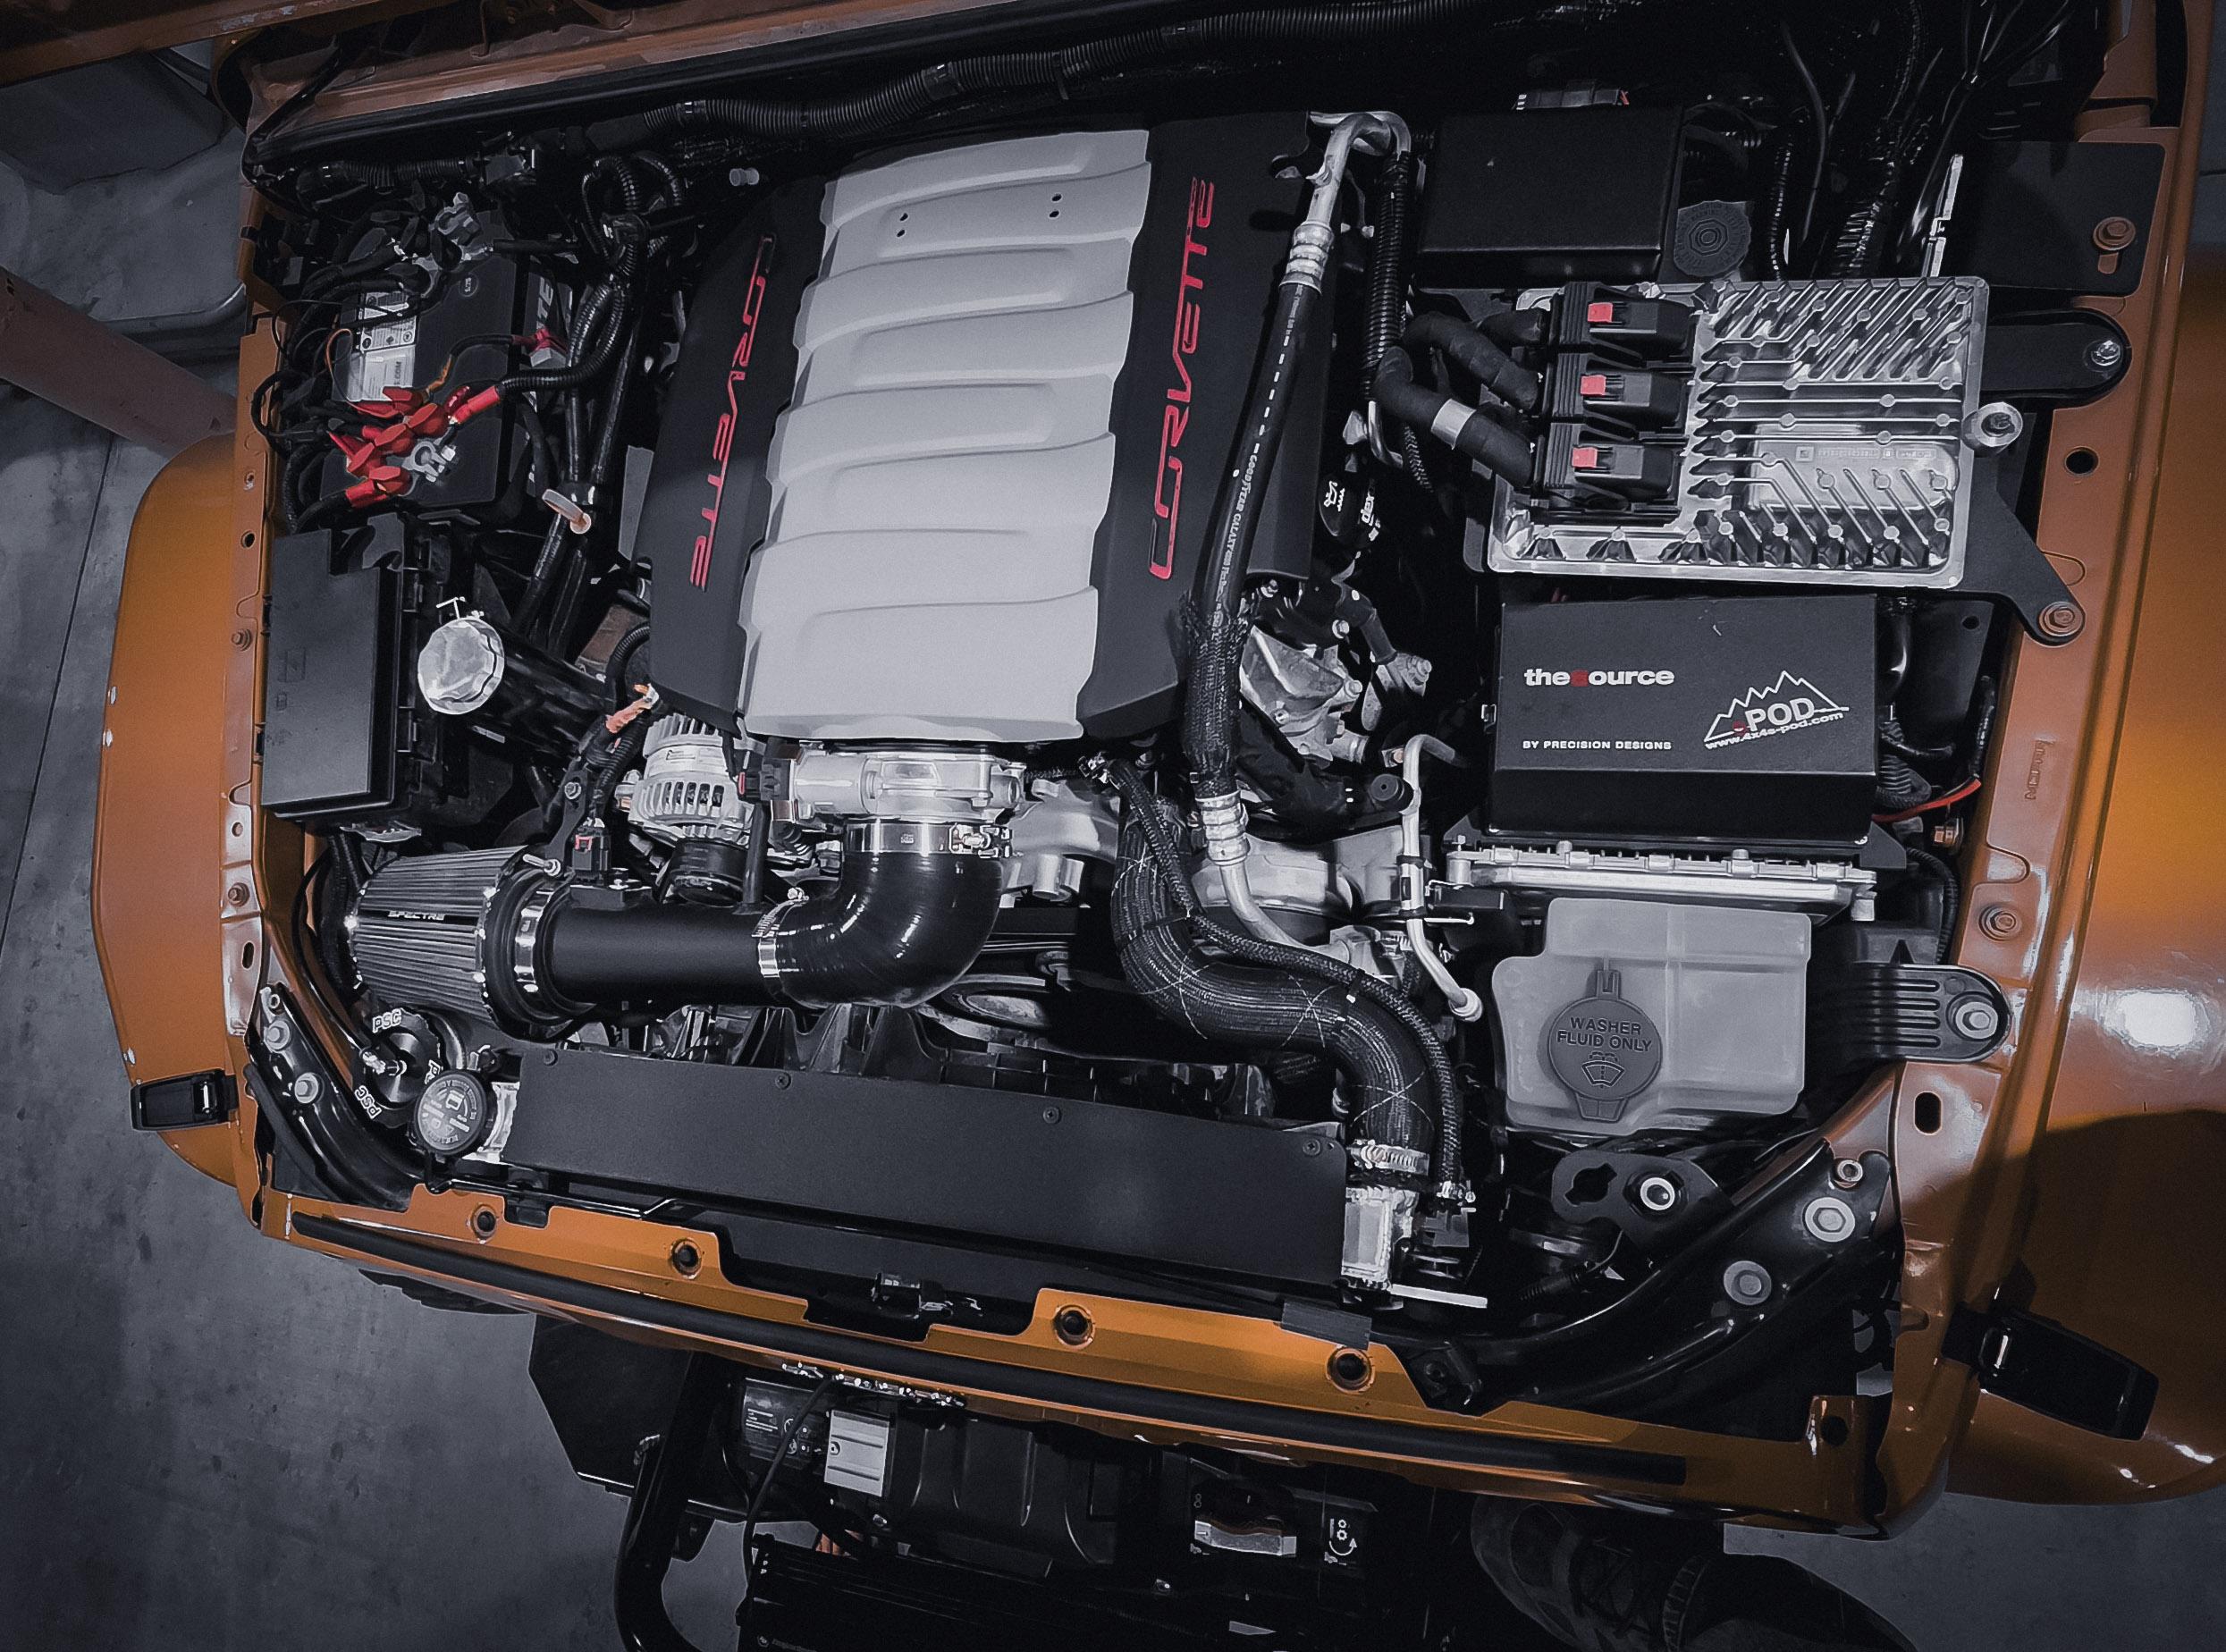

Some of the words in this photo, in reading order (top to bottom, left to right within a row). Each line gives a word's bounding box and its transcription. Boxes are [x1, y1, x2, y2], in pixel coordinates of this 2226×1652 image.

[1149, 176, 1215, 579] CORVETTE
[689, 232, 777, 593] CORVETTE
[1235, 454, 1258, 512] GOODYEAR
[1523, 668, 1675, 687] theource
[1522, 740, 1539, 749] BY
[1543, 740, 1611, 749] PRECISION
[1615, 740, 1672, 750] DESIGNS
[387, 910, 446, 922] SPECTRE
[372, 1007, 402, 1033] PSC
[1570, 1016, 1642, 1035] WASHER
[1556, 1029, 1605, 1048] FLUID
[1609, 1035, 1652, 1052] ONLY
[354, 1084, 382, 1120] PSC
